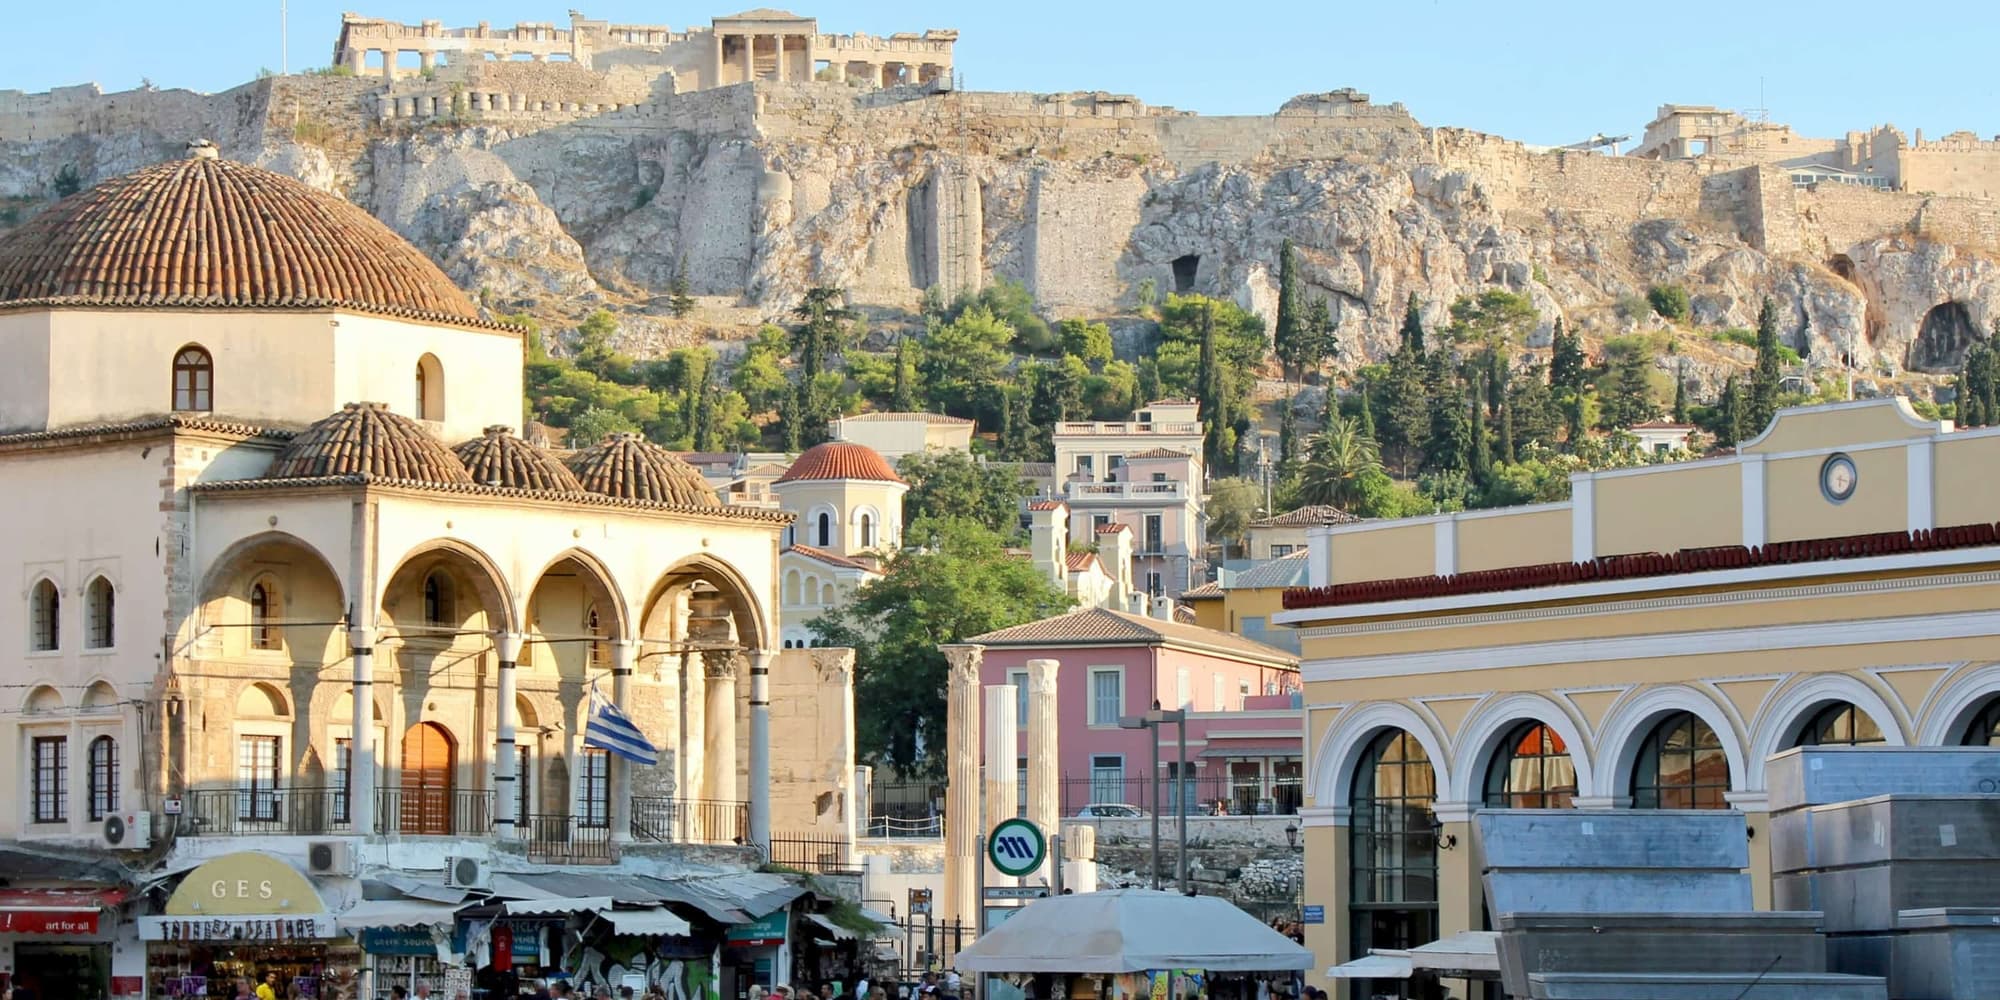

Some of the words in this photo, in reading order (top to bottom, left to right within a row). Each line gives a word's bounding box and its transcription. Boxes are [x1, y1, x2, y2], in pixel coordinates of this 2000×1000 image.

[211, 879, 273, 899] GES
[45, 922, 59, 930] art
[61, 921, 76, 930] for
[77, 921, 89, 930] all
